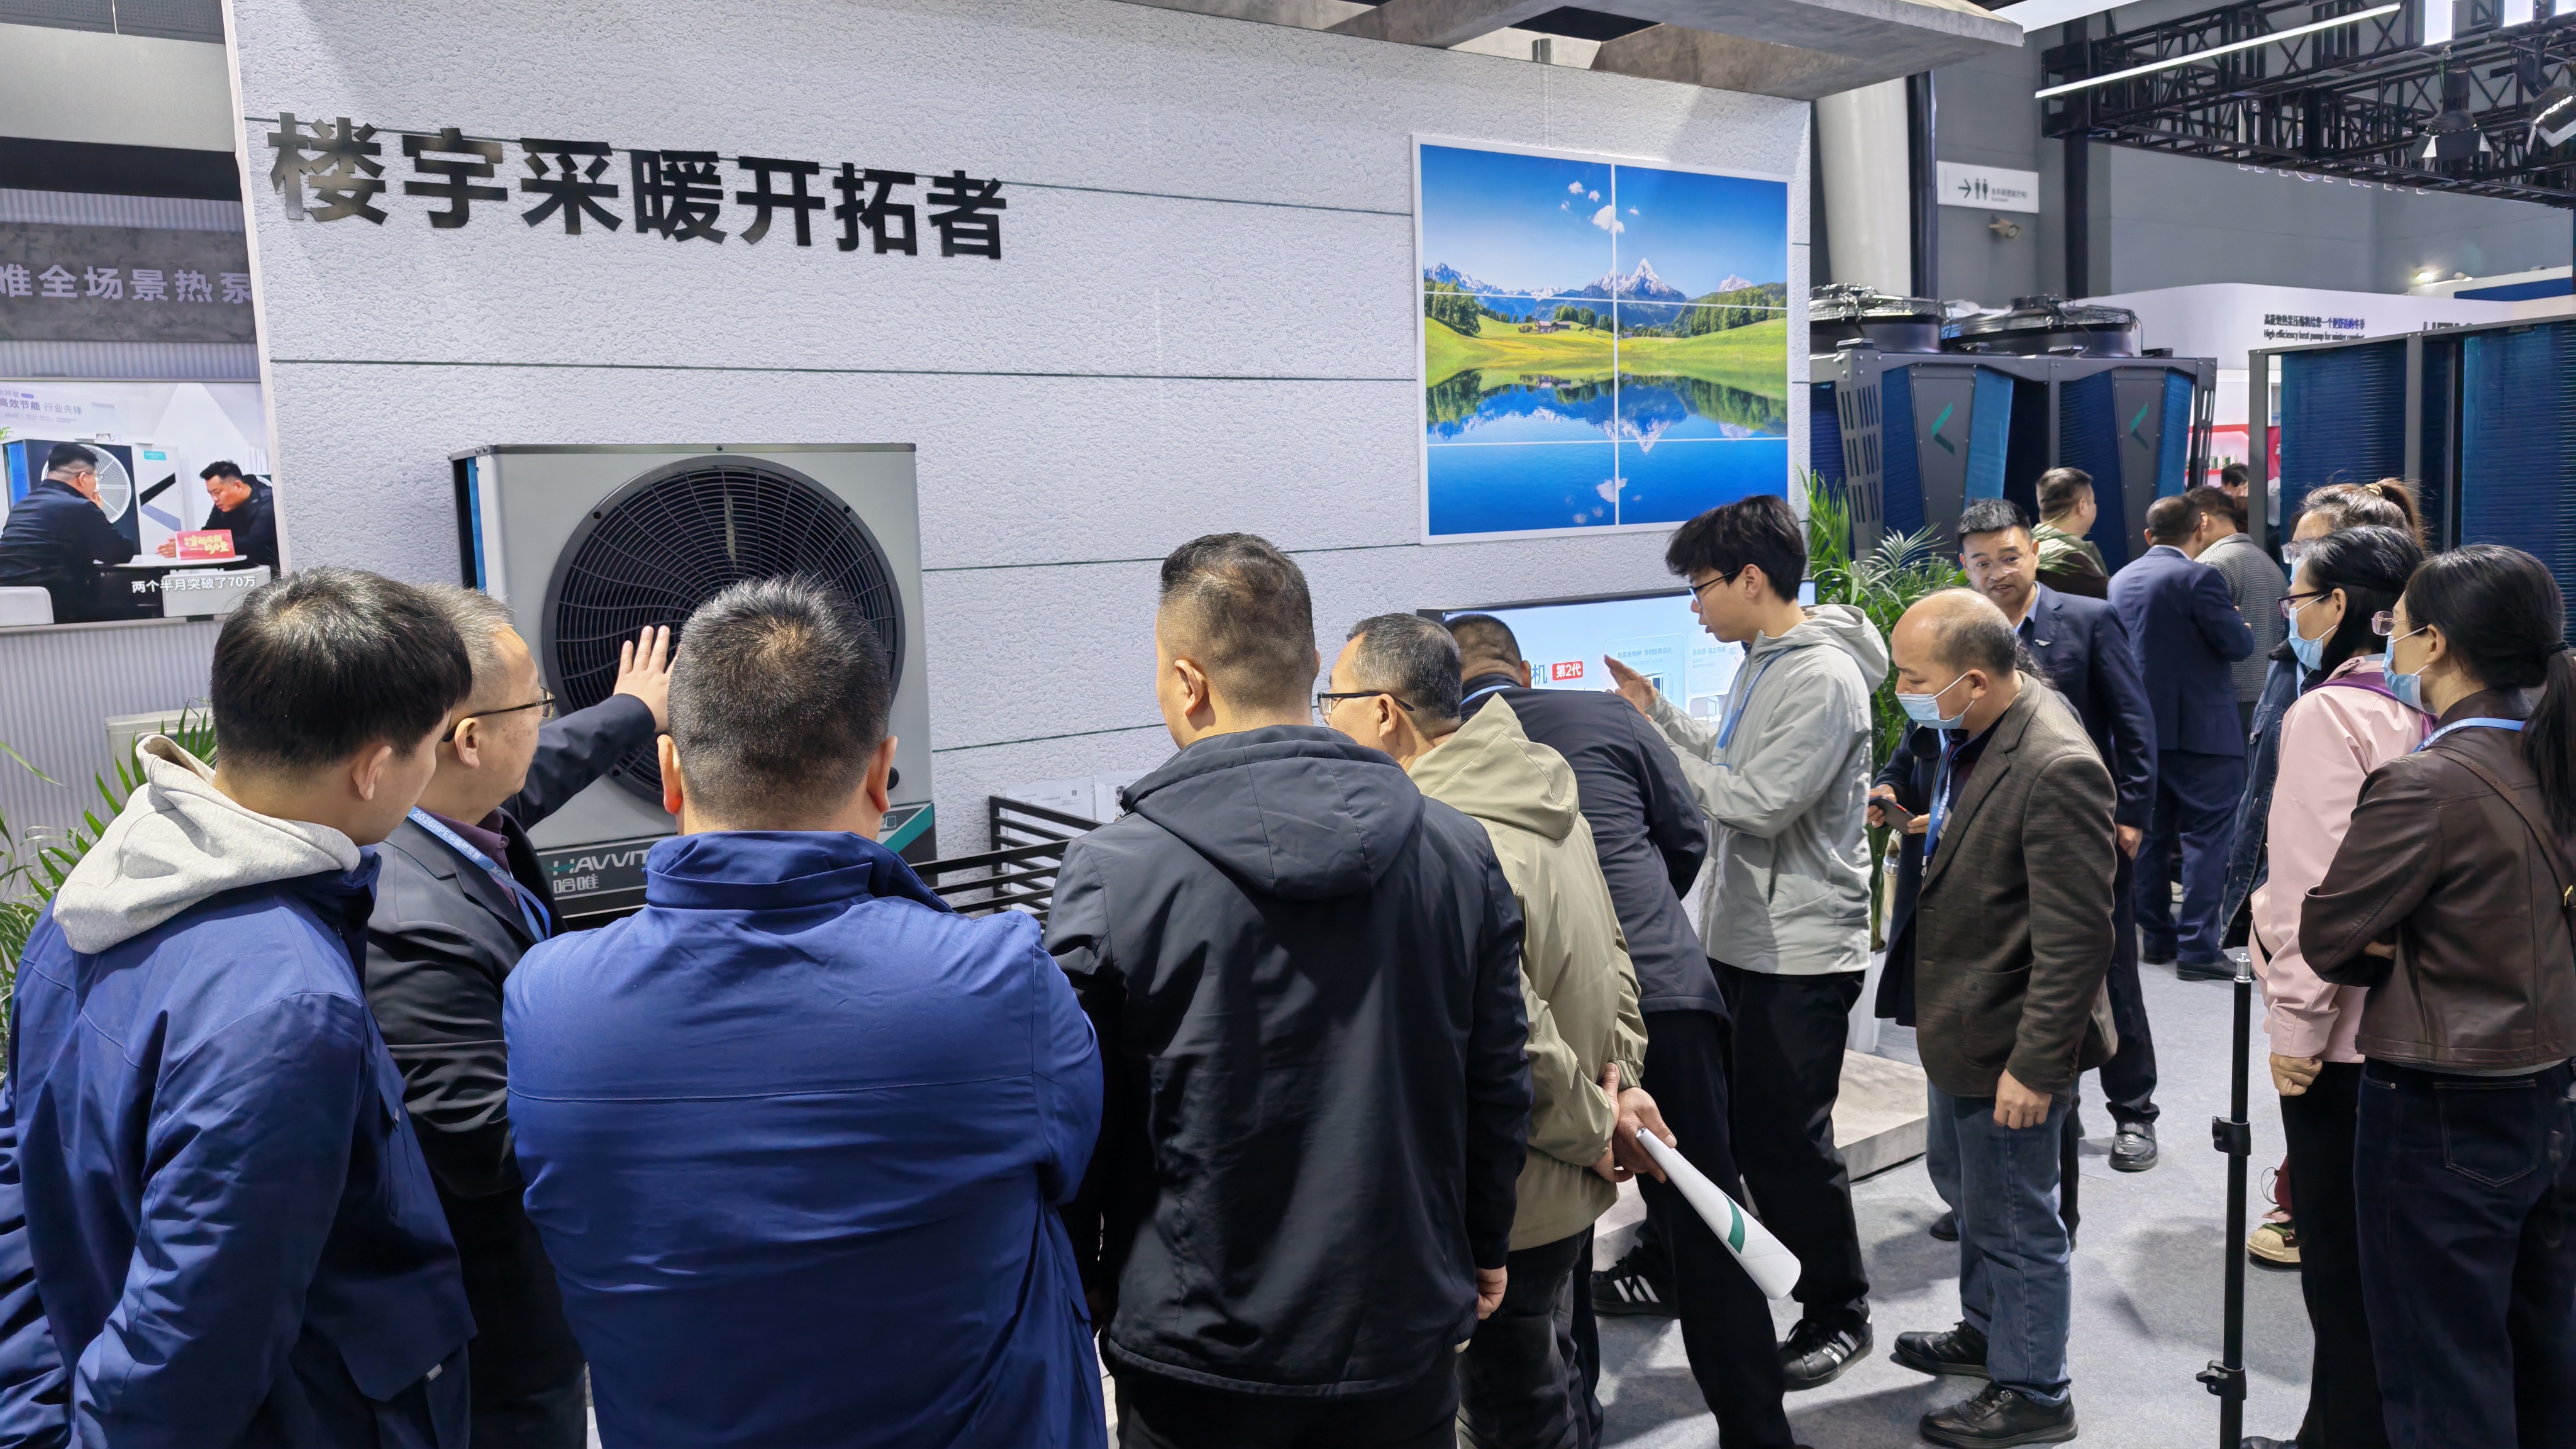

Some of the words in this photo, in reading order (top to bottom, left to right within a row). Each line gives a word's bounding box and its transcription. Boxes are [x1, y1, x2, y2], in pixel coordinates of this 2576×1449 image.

[267, 112, 1006, 260] 楼宇采暖开拓者
[44, 402, 82, 415] 行业先锋
[131, 575, 255, 594] 两个半月突破了70万
[1555, 662, 1582, 679] 第2代
[553, 873, 599, 894] 哈唯
